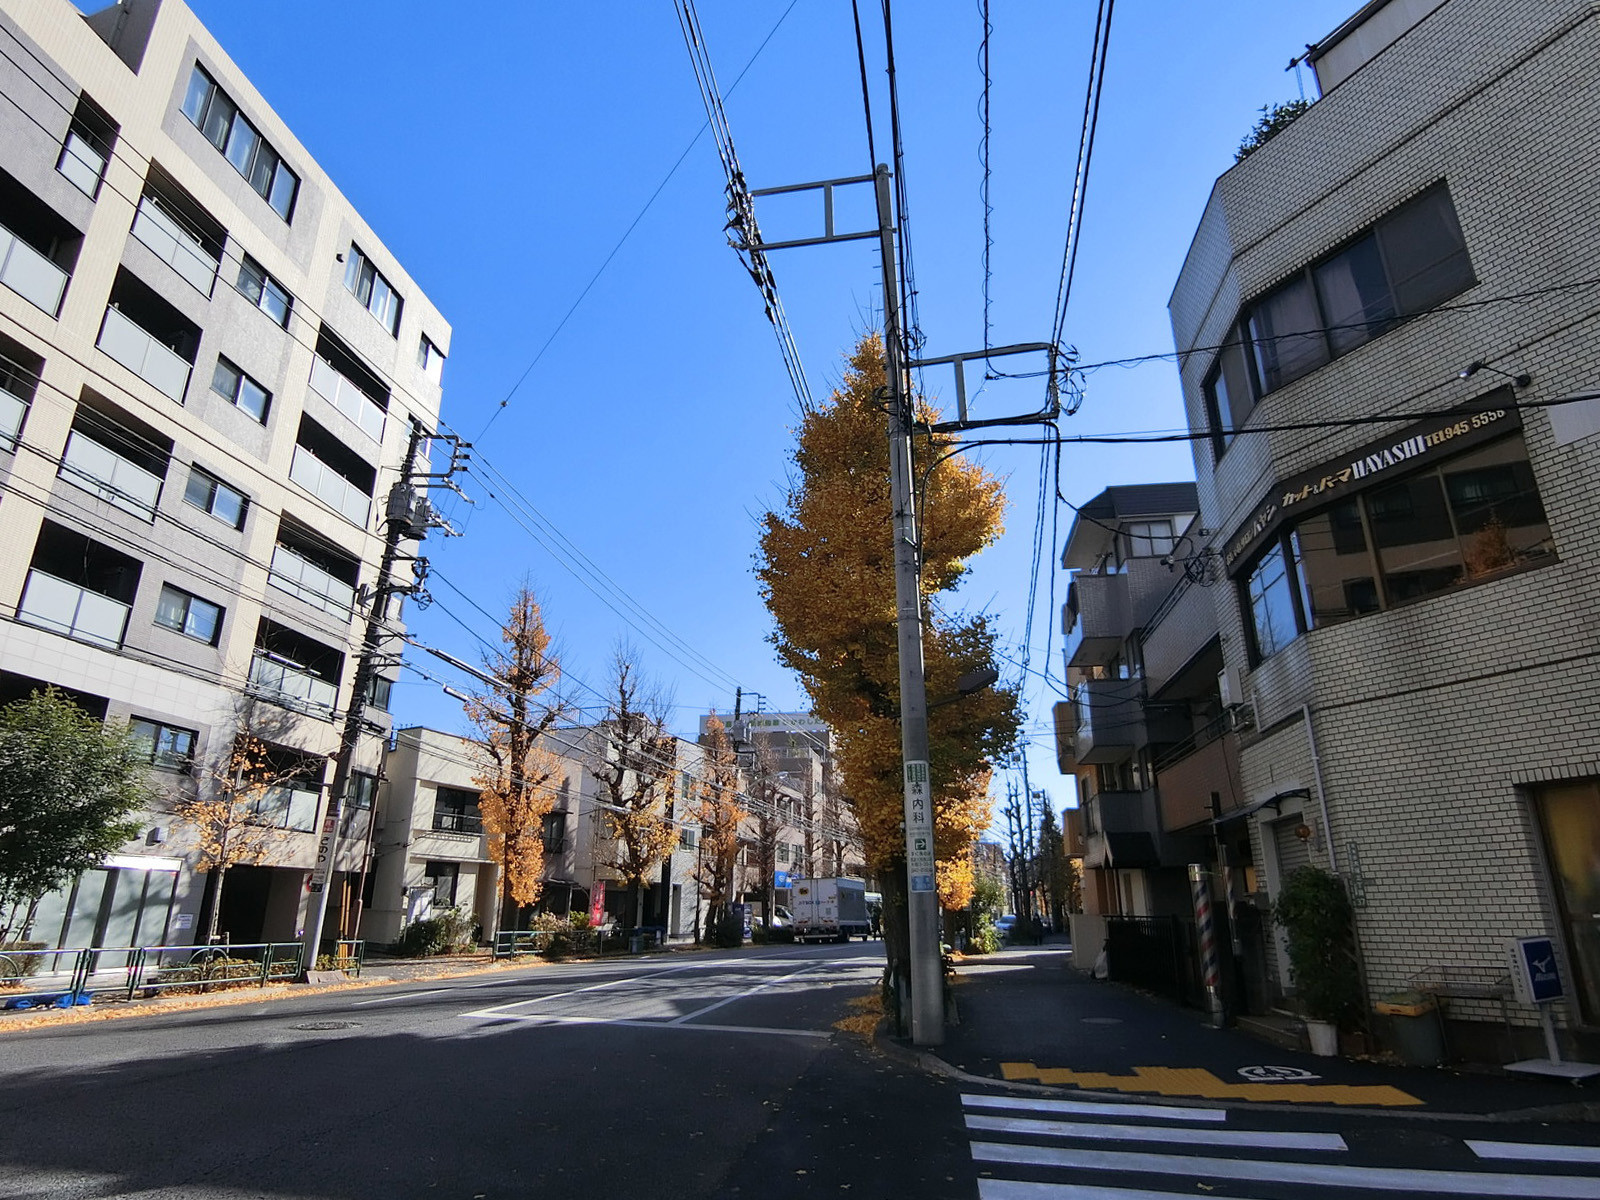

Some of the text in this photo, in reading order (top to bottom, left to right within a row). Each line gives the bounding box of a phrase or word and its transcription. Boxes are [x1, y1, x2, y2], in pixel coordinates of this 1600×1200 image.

[1352, 435, 1426, 480] HAYASHI
[912, 782, 924, 823] 森内科
